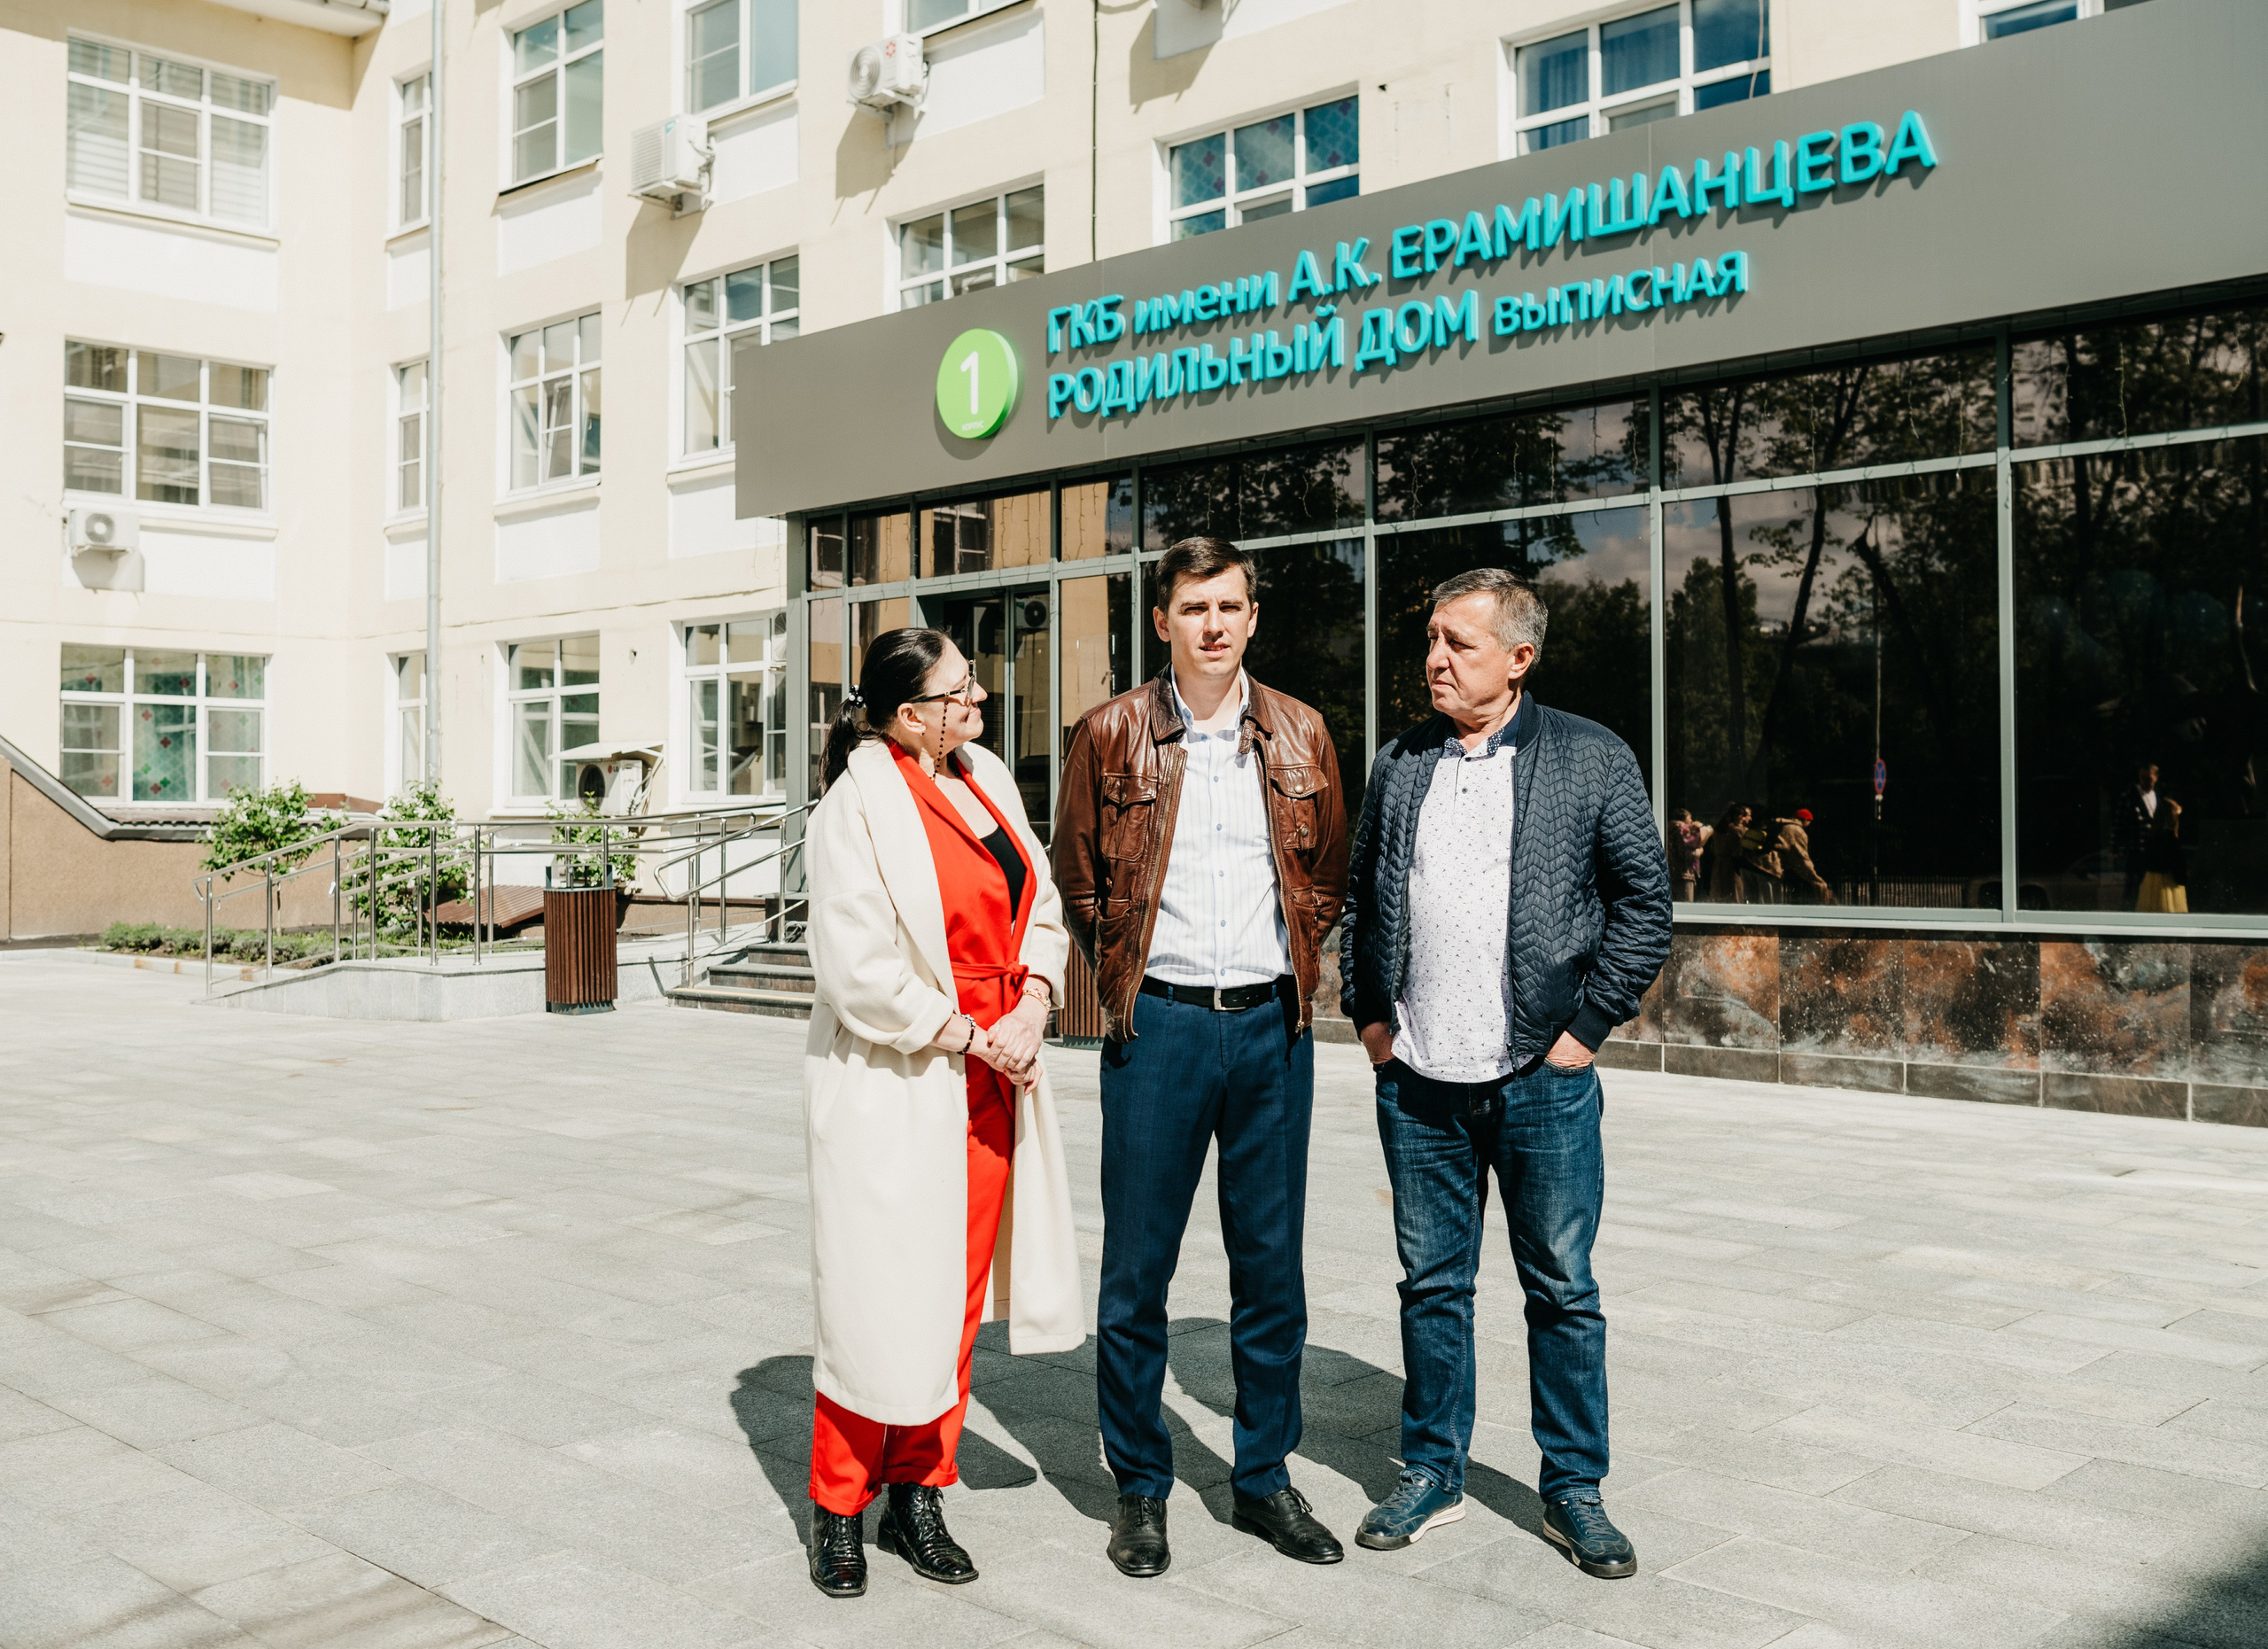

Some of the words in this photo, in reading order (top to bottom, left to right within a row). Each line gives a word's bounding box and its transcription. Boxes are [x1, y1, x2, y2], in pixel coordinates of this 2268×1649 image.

[1048, 293, 1126, 354] ГКБ
[1135, 270, 1278, 334] имени
[1393, 110, 1938, 279] ЕРАМИШАНЦЕВА
[959, 351, 979, 415] 1
[1048, 303, 1344, 418] РОДИЛЬНЫЙ
[1355, 290, 1479, 371] ДОМ
[1495, 251, 1749, 335] выписная
